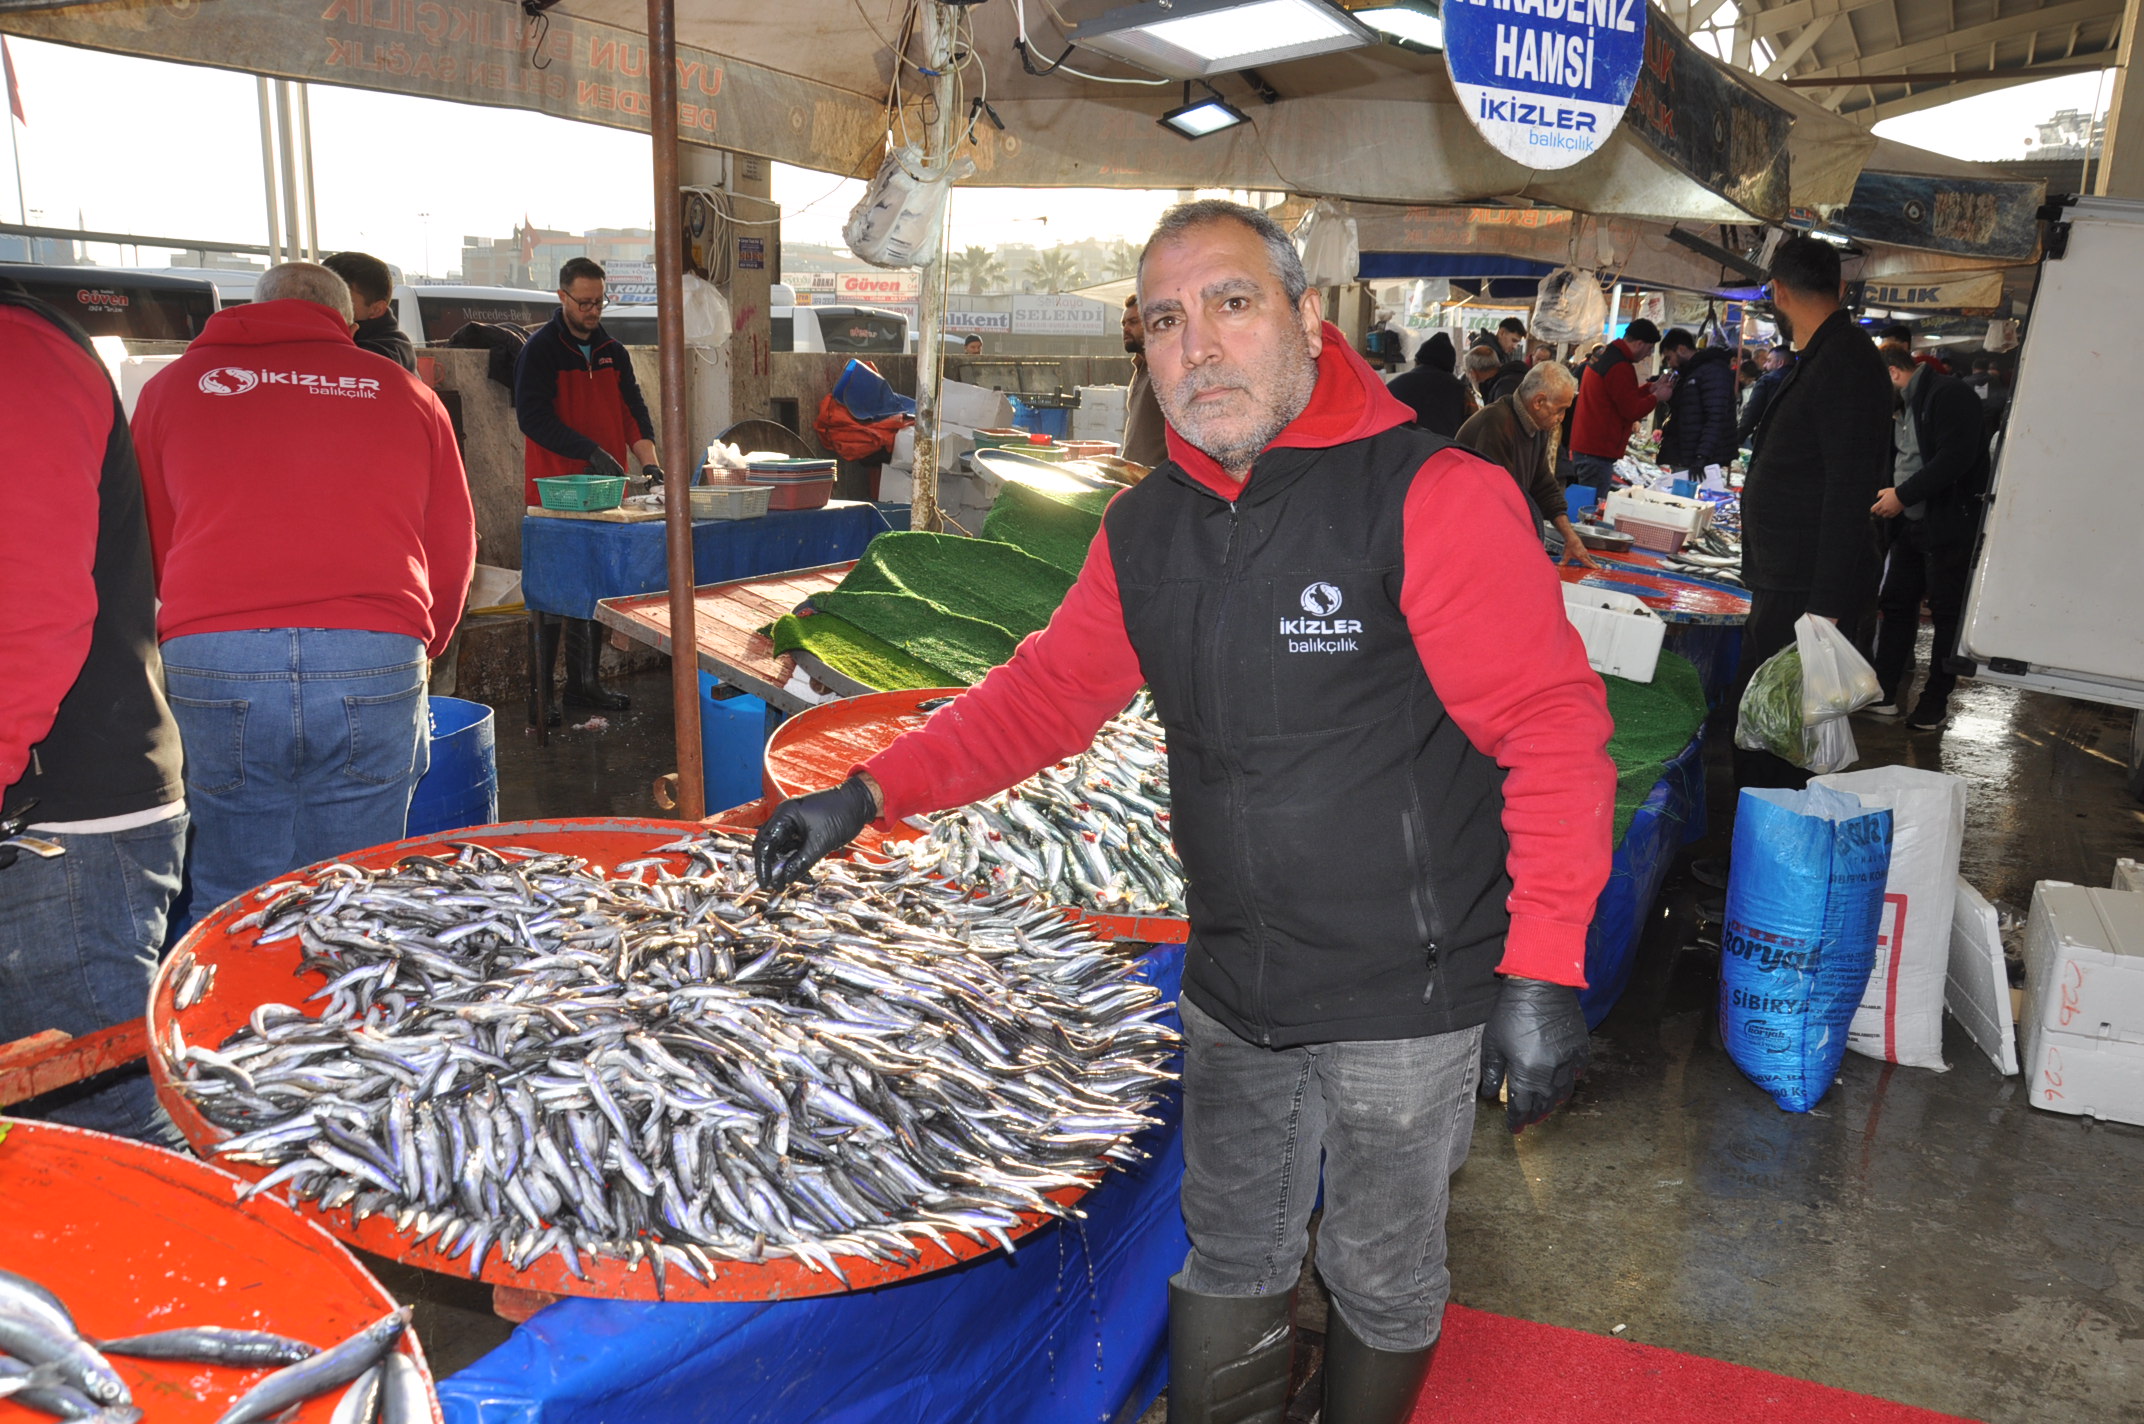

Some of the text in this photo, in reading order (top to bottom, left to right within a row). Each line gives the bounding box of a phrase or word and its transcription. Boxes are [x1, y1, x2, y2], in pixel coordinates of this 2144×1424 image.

[1453, 0, 1636, 33] DENİZ
[1494, 24, 1595, 90] HAMSİ
[1480, 92, 1596, 133] İKİZLER
[1529, 129, 1595, 152] balıkçılık
[845, 277, 901, 292] Güven
[77, 289, 129, 306] Güven
[462, 308, 532, 320] Mercedes-Benz
[1014, 306, 1103, 321] SELENDİ
[261, 369, 381, 391] İKİZLER
[309, 386, 377, 399] balıkçılık
[1279, 616, 1364, 635] İKİZLER
[1288, 638, 1359, 655] balıkçılık
